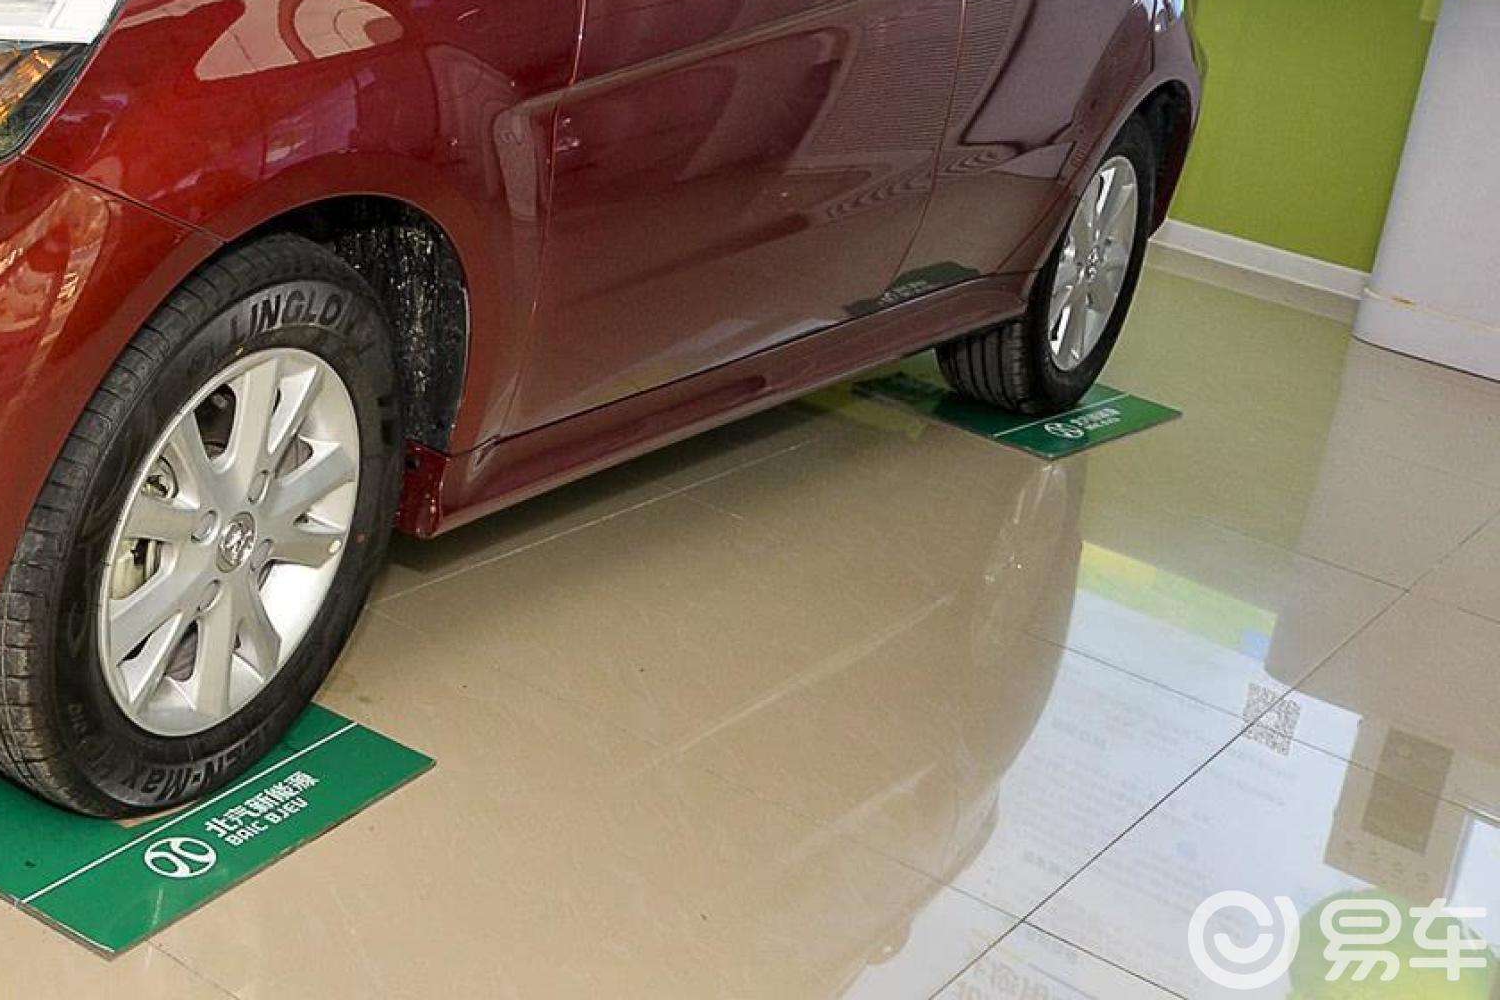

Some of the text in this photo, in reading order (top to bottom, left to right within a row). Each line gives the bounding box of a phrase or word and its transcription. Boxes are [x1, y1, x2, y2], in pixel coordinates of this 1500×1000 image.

[204, 770, 320, 838] 北汽新能源
[225, 820, 268, 846] BAIC
